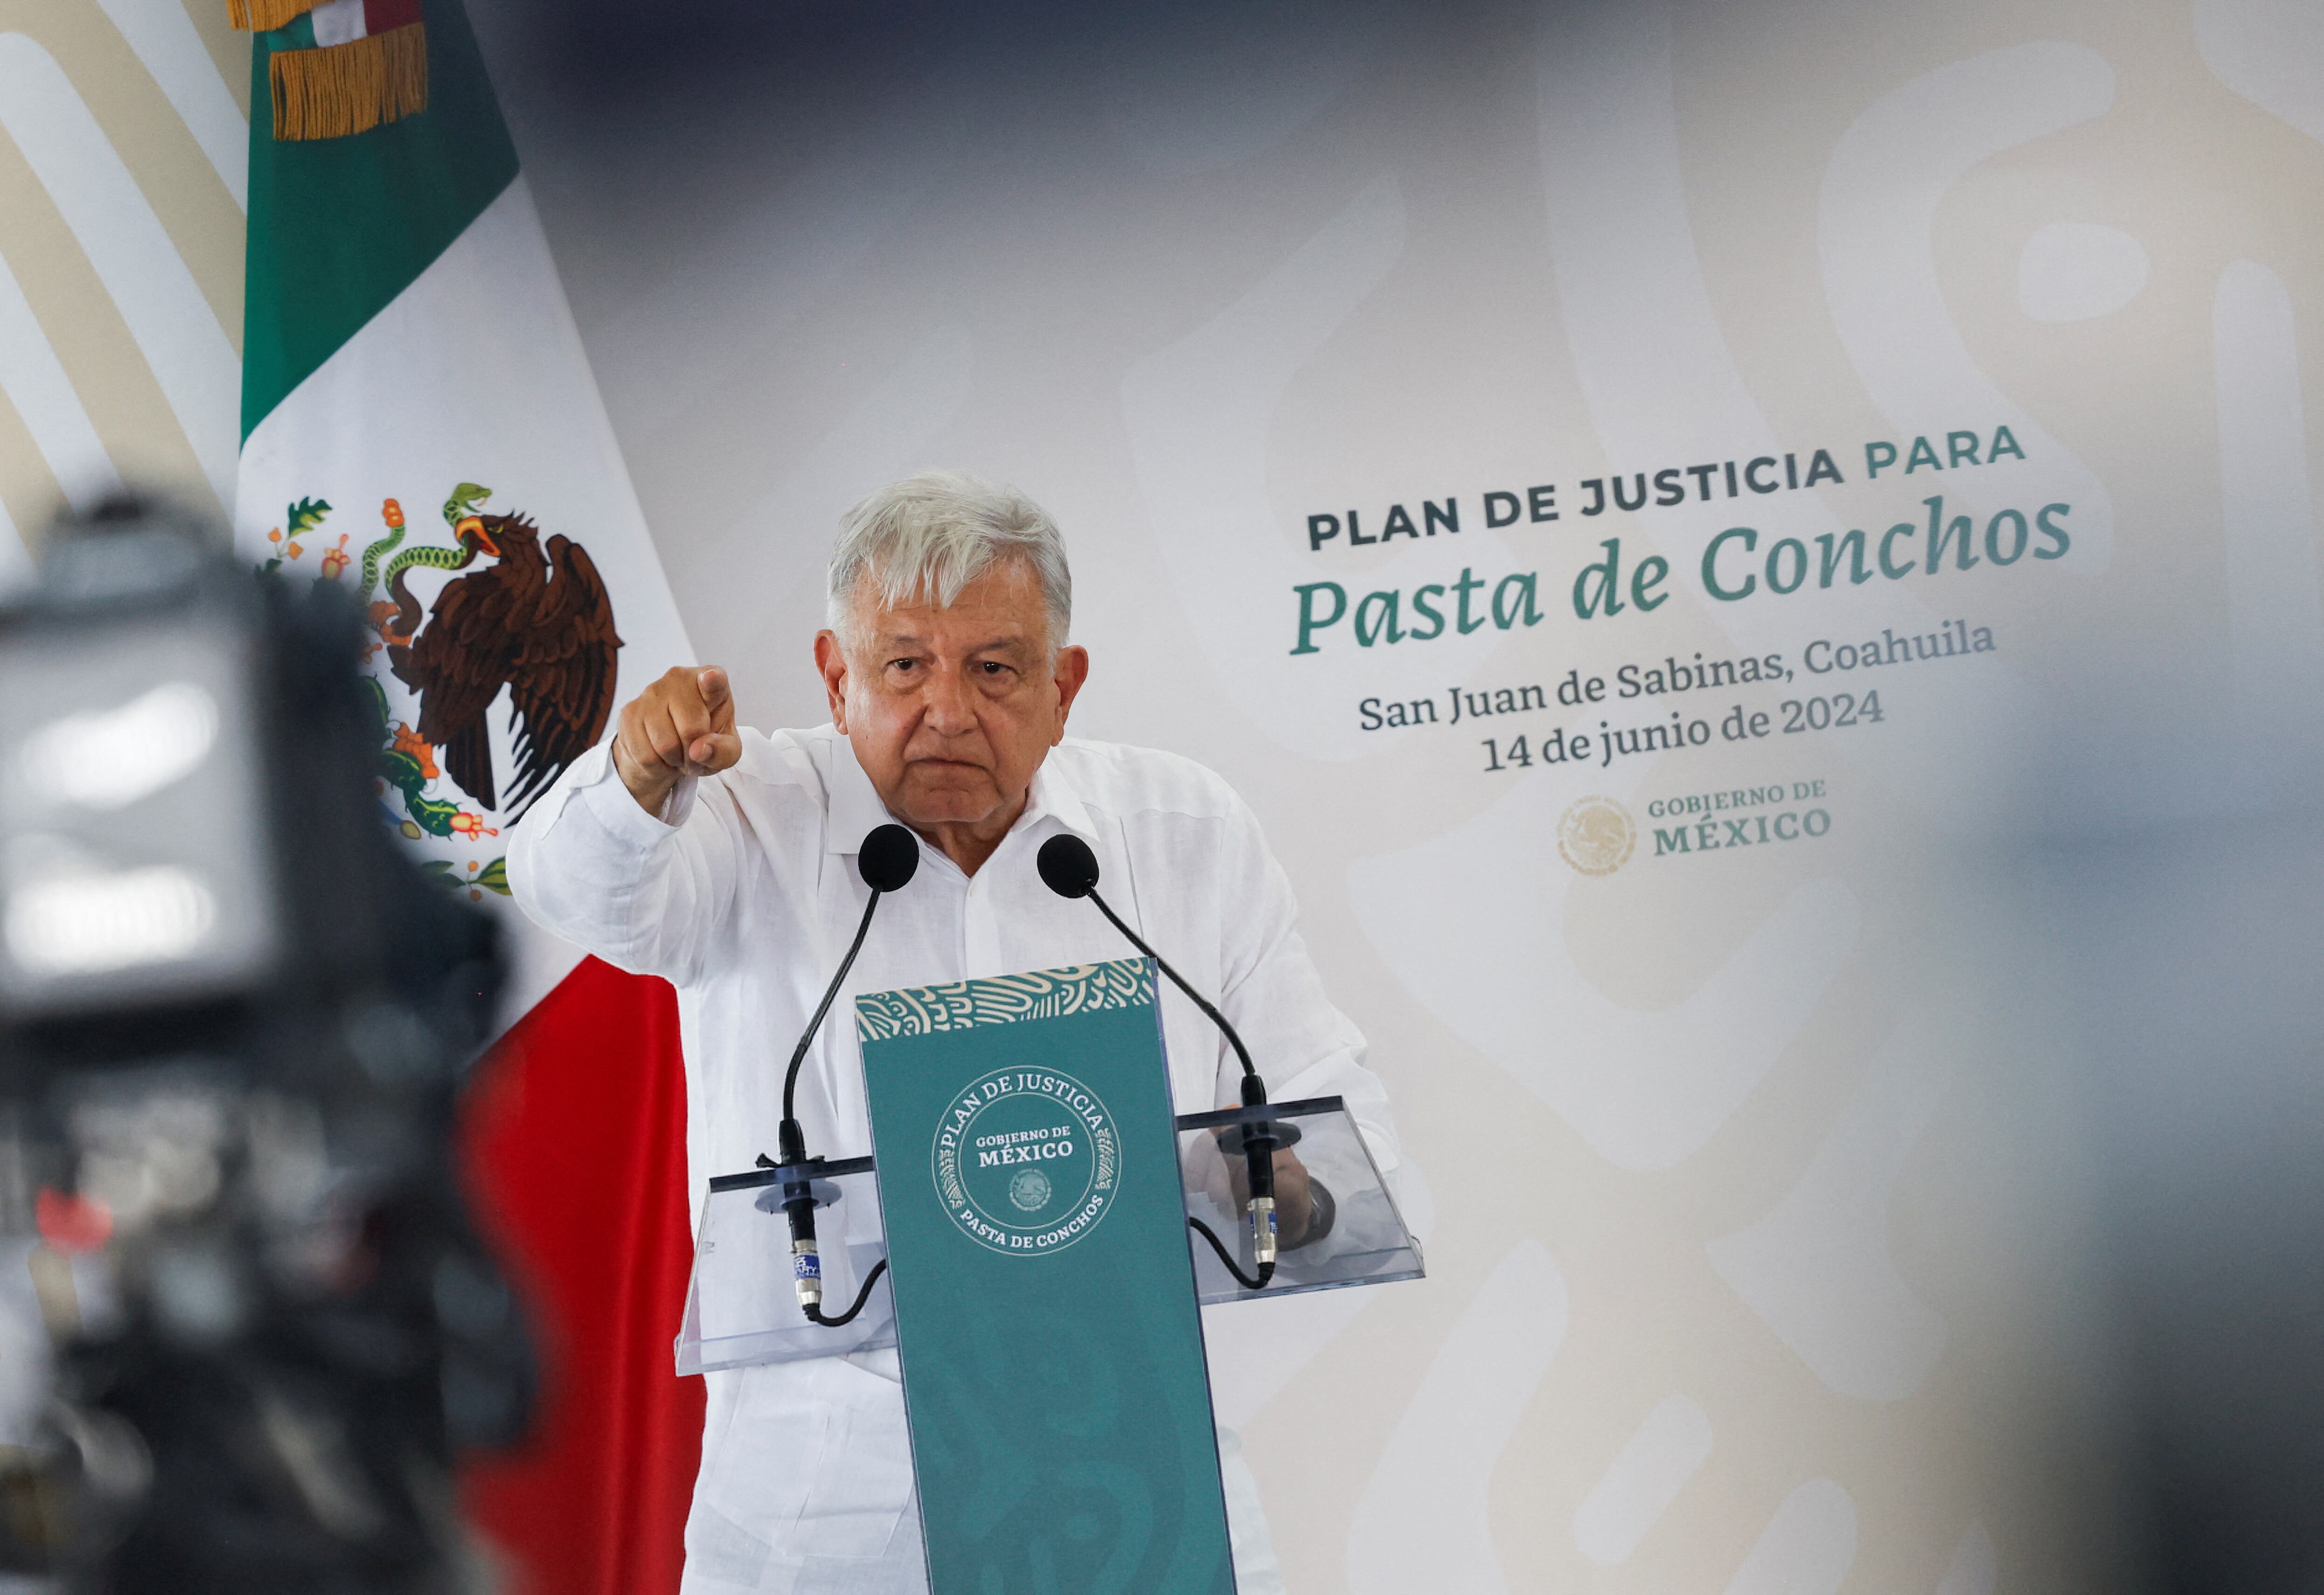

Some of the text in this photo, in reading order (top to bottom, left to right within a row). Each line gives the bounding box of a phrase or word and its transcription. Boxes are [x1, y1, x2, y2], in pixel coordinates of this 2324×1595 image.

[1307, 425, 2025, 551] PLAN DE JUSTICIA PARA
[1289, 495, 2073, 656] Pasta de Conchos
[1358, 620, 1997, 731] San Juan de Sabinas, Coahuila
[1482, 690, 1885, 772] 14 de junio de 2024
[1648, 785, 1786, 817] GOBIERNO
[1792, 779, 1826, 800] DE
[1652, 807, 1831, 857] MÉXICO
[941, 1073, 1104, 1149] PLAN DE JUSTICIA
[975, 1125, 1071, 1148] GOBIERNO DE
[979, 1141, 1073, 1168] MÉXICO
[960, 1195, 1104, 1248] PASTA DE CONCHOS
